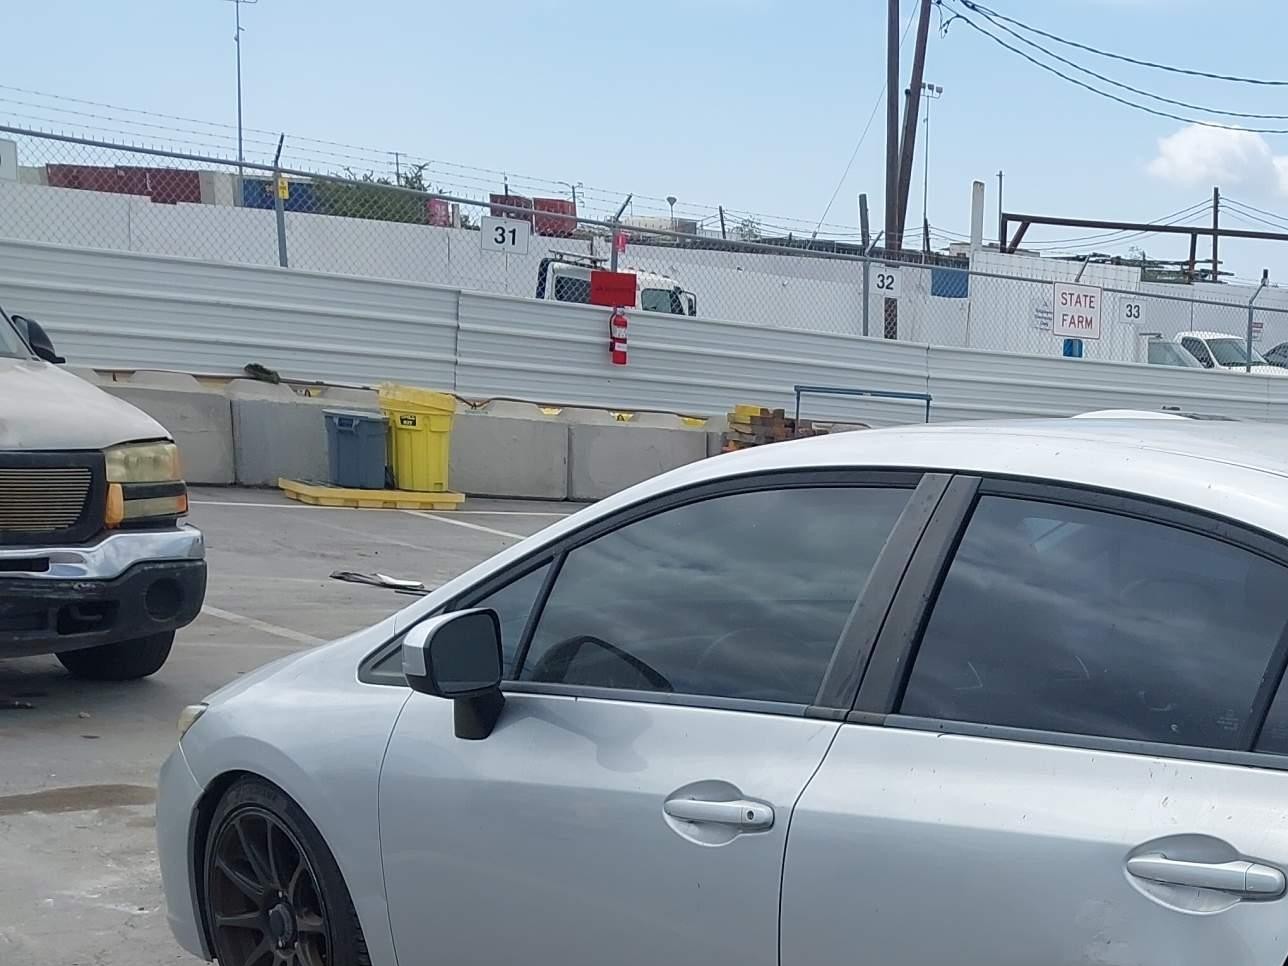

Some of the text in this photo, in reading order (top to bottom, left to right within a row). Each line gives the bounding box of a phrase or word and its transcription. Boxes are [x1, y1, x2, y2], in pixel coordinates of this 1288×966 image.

[494, 226, 517, 246] 31
[877, 274, 894, 290] 32
[1060, 291, 1096, 310] STATE
[1125, 303, 1140, 319] 33
[1061, 313, 1094, 330] FARM
